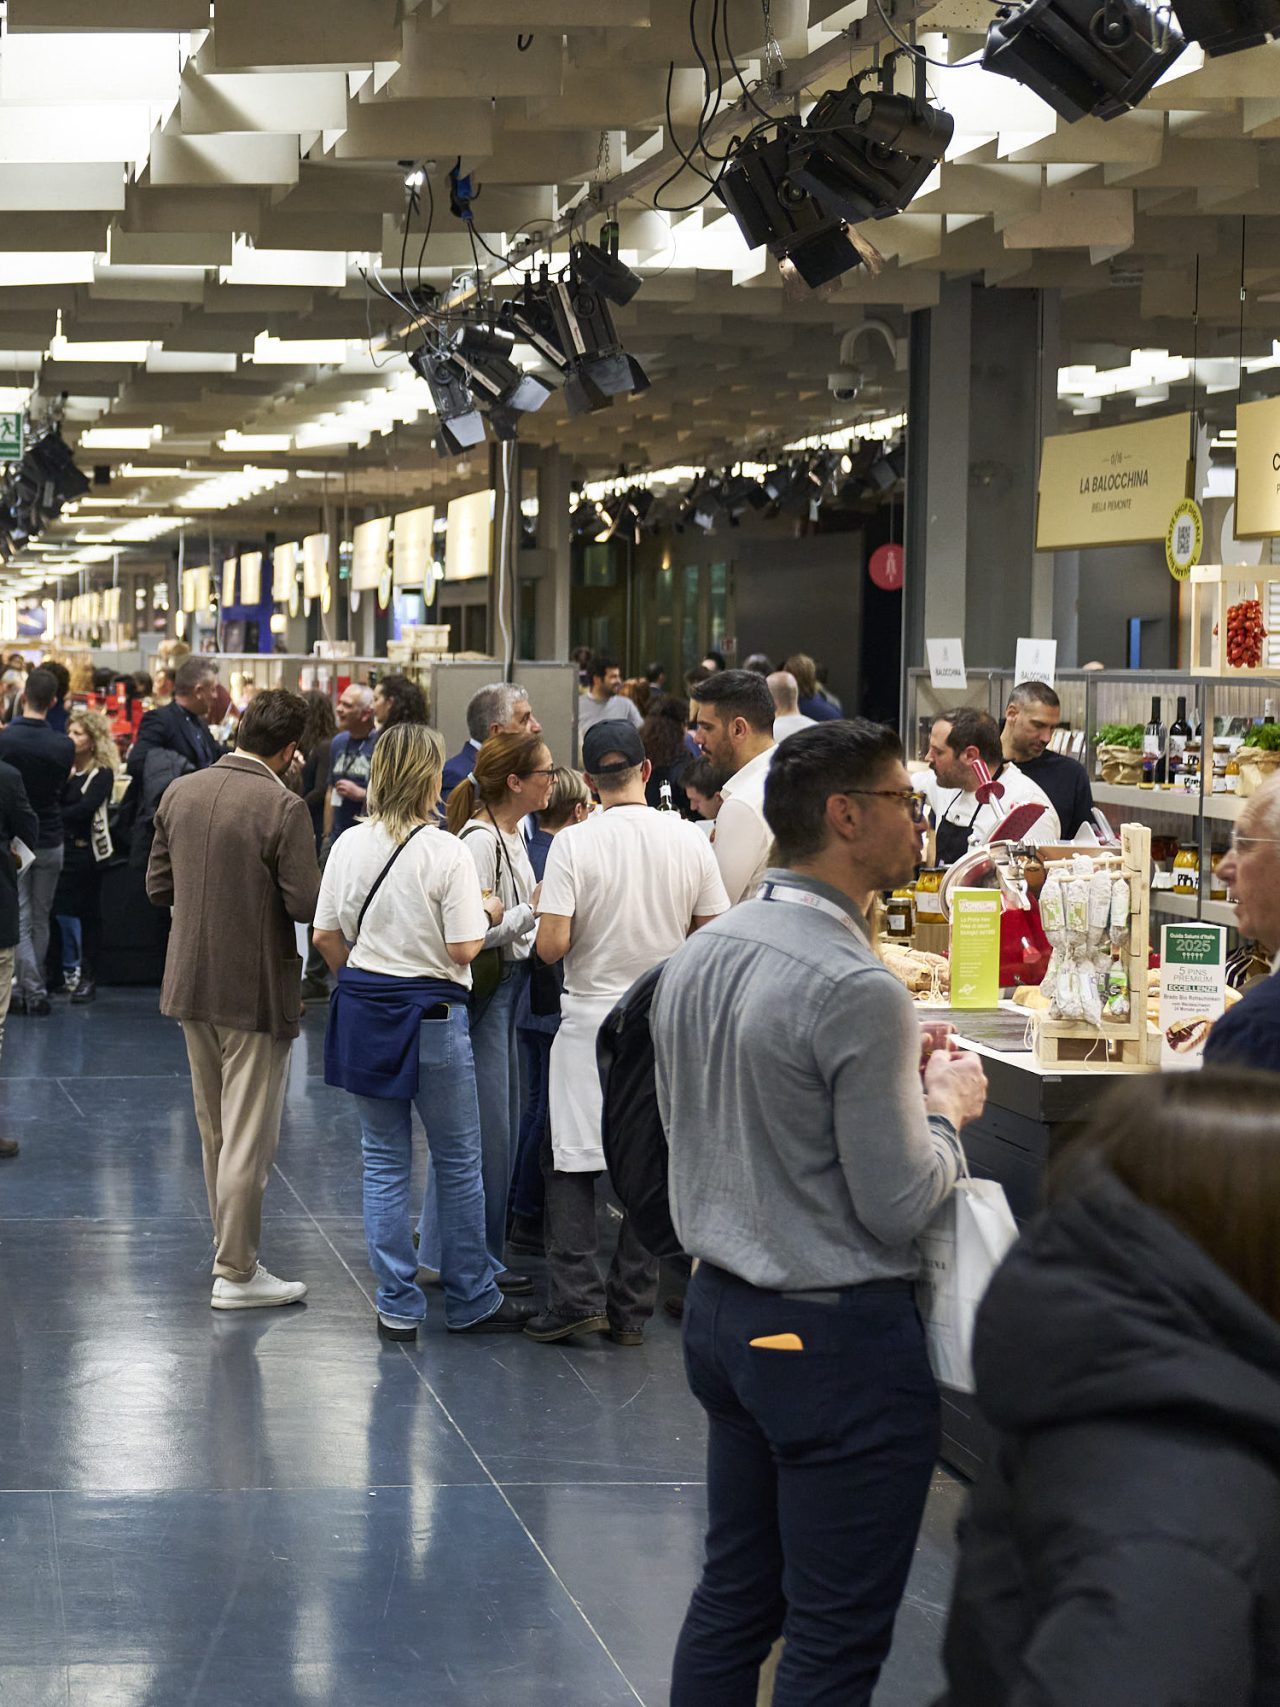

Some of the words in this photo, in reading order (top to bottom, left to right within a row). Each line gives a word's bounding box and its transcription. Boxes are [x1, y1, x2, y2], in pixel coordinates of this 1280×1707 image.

[1079, 477, 1090, 495] LA
[1092, 469, 1149, 492] BALOCCHINA
[1091, 501, 1107, 513] BIELLA
[1108, 498, 1132, 511] PIEMONTE
[1176, 939, 1211, 952] 2025
[1179, 966, 1186, 976] 5
[1187, 968, 1208, 976] PINS
[1173, 975, 1213, 983] PREMIUM
[1169, 984, 1218, 992] ECCELLENZE
